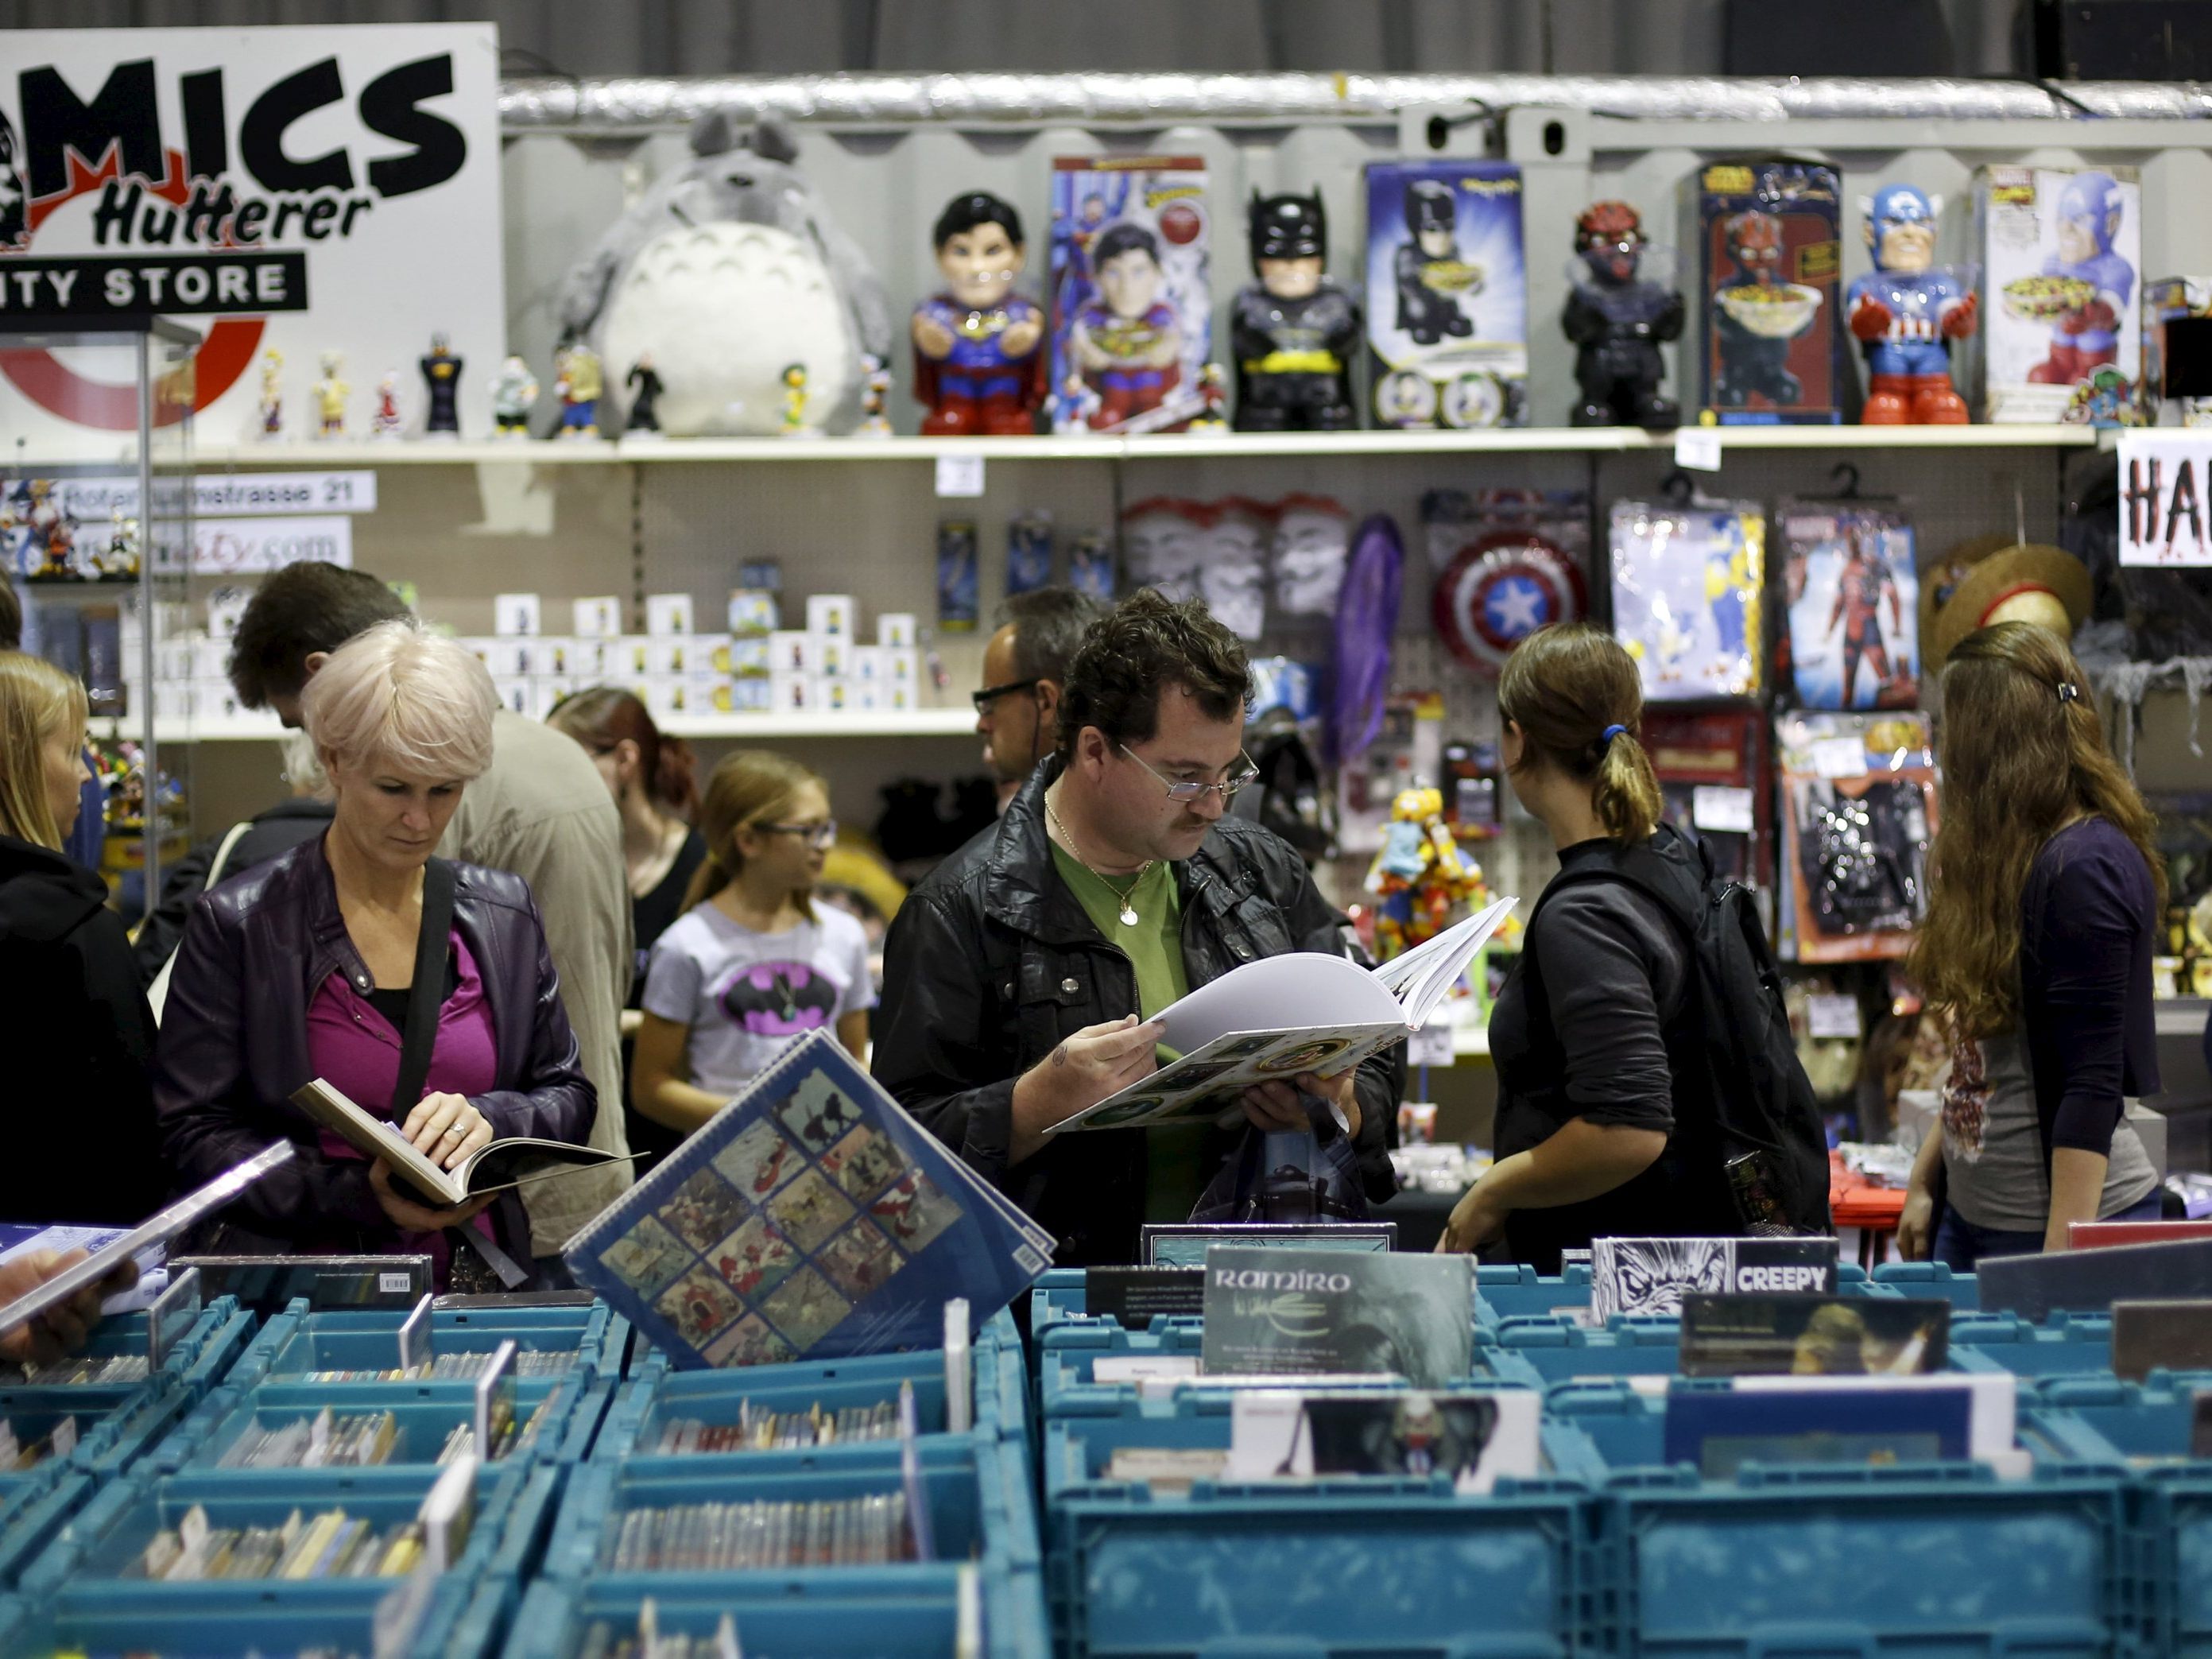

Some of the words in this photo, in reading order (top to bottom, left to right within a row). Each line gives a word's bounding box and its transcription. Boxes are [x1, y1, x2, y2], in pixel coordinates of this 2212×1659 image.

[95, 182, 372, 244] Hutterer
[104, 264, 287, 307] STORE
[324, 477, 352, 501] 21
[2122, 455, 2212, 554] HA
[1737, 1266, 1827, 1292] CREEPY
